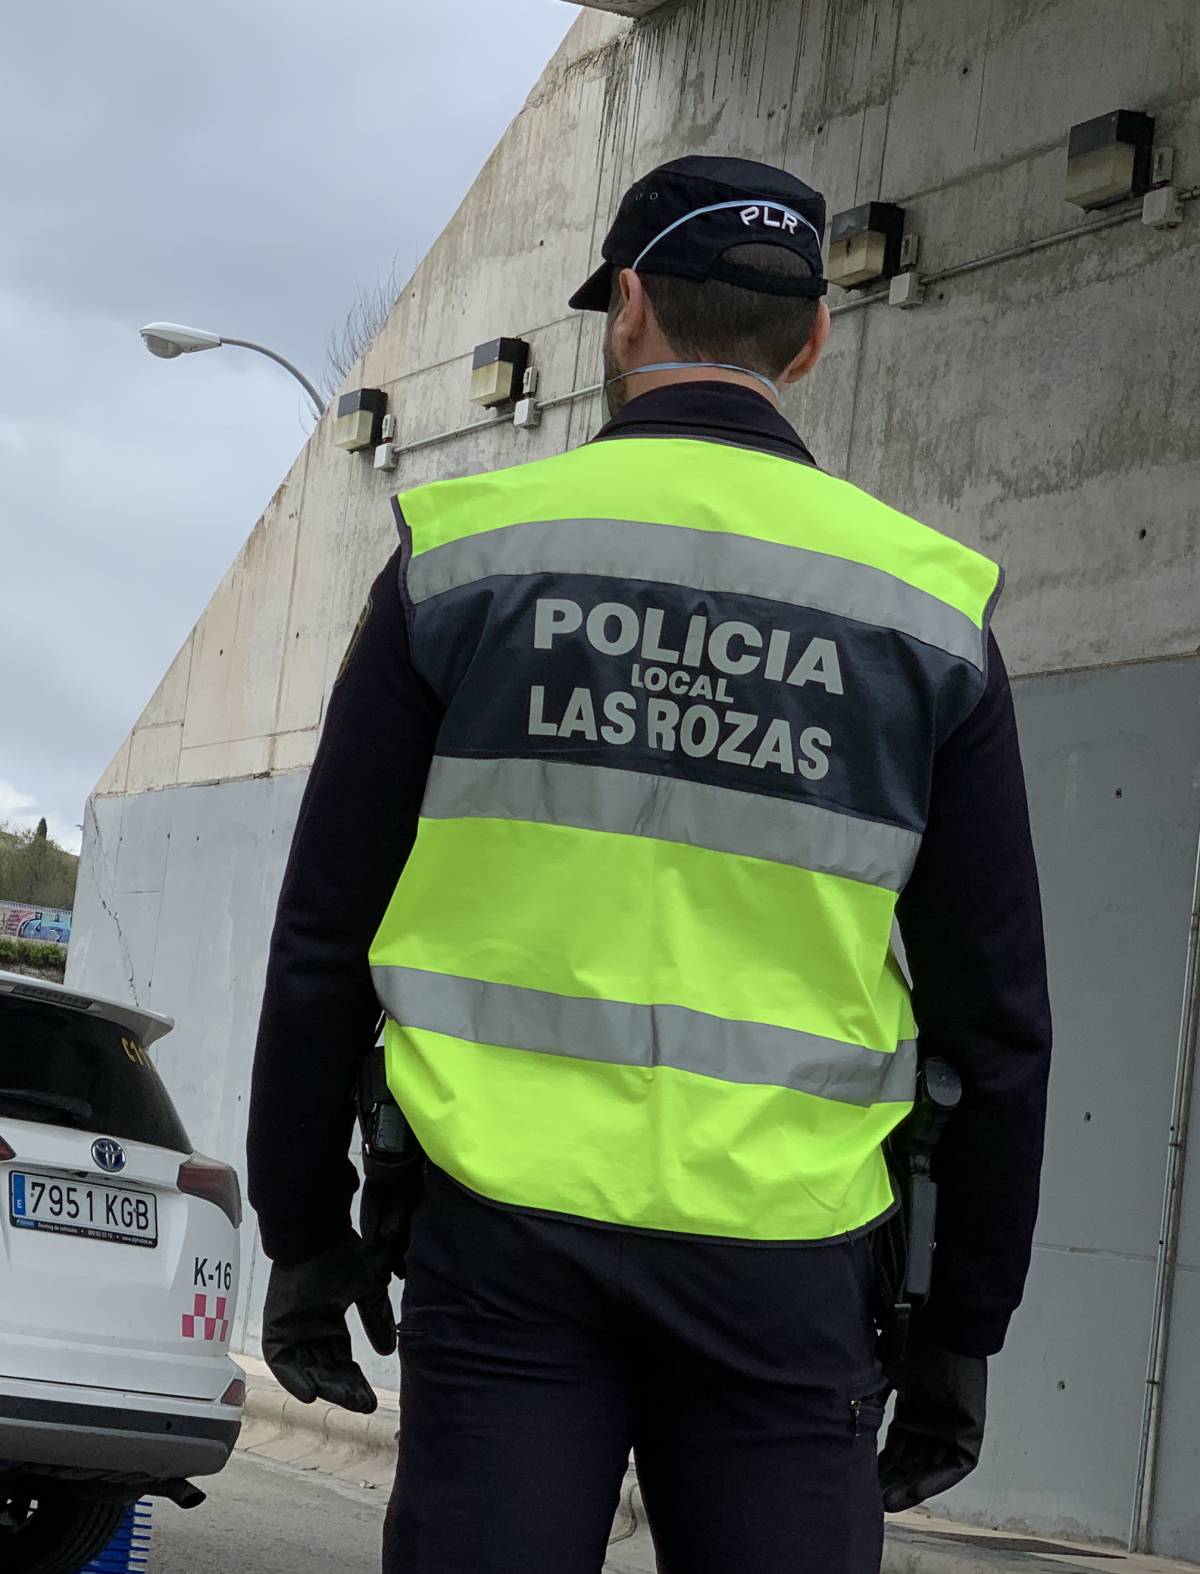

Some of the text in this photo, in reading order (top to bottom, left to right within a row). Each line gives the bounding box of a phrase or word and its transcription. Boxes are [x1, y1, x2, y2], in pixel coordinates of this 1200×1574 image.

[740, 206, 798, 234] PLR
[533, 598, 844, 695] POLICIA
[631, 663, 734, 704] LOCAL
[528, 685, 832, 780] LAS ROZAS
[31, 1182, 149, 1230] 7951 KGB
[193, 1257, 232, 1290] K-16
